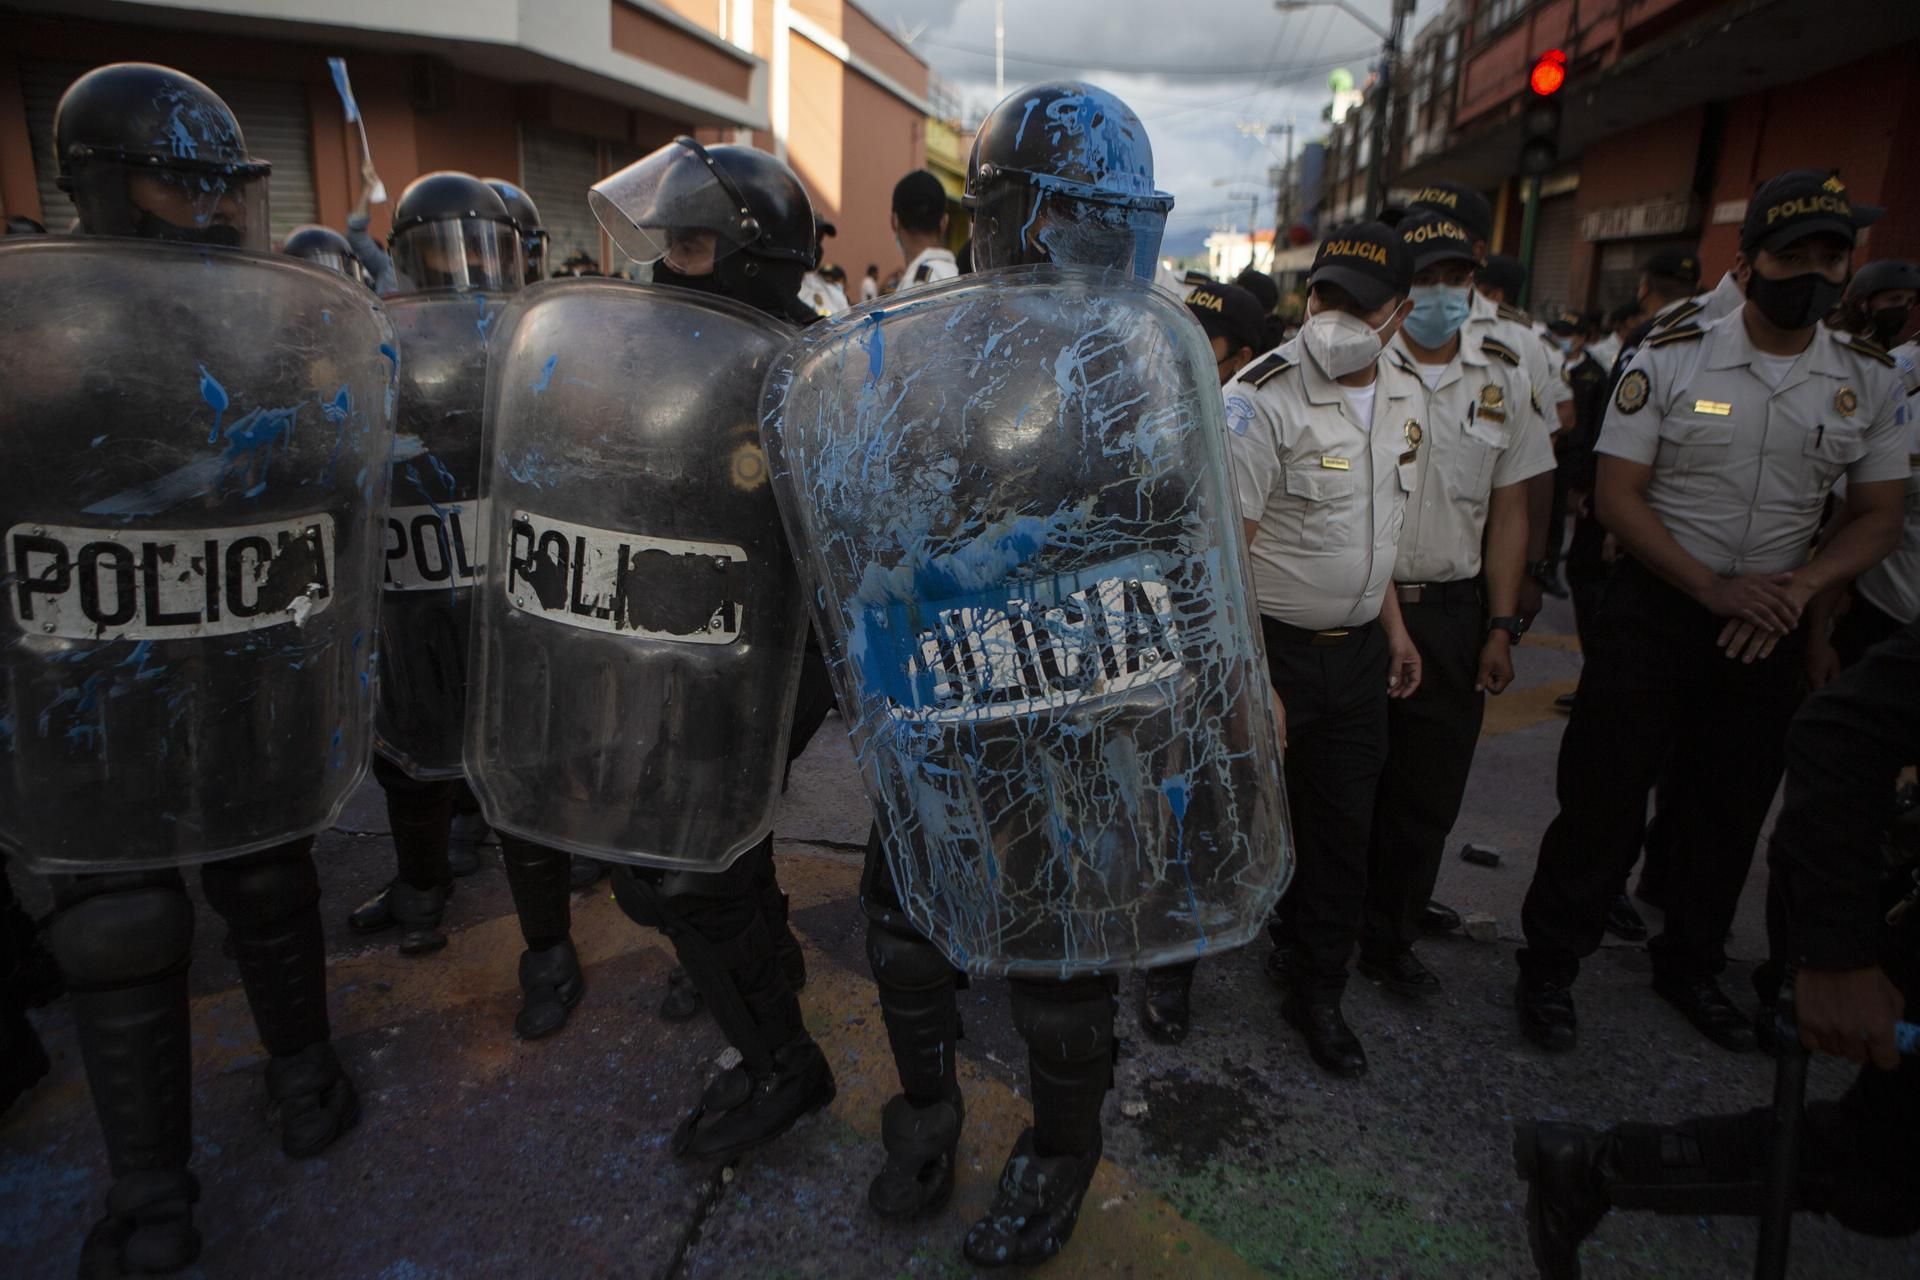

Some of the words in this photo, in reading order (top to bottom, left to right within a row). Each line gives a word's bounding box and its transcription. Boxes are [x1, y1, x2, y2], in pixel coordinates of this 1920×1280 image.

[1767, 196, 1851, 225] POLICIA
[1402, 221, 1468, 243] POLICIA
[1322, 240, 1387, 266] POLICIA
